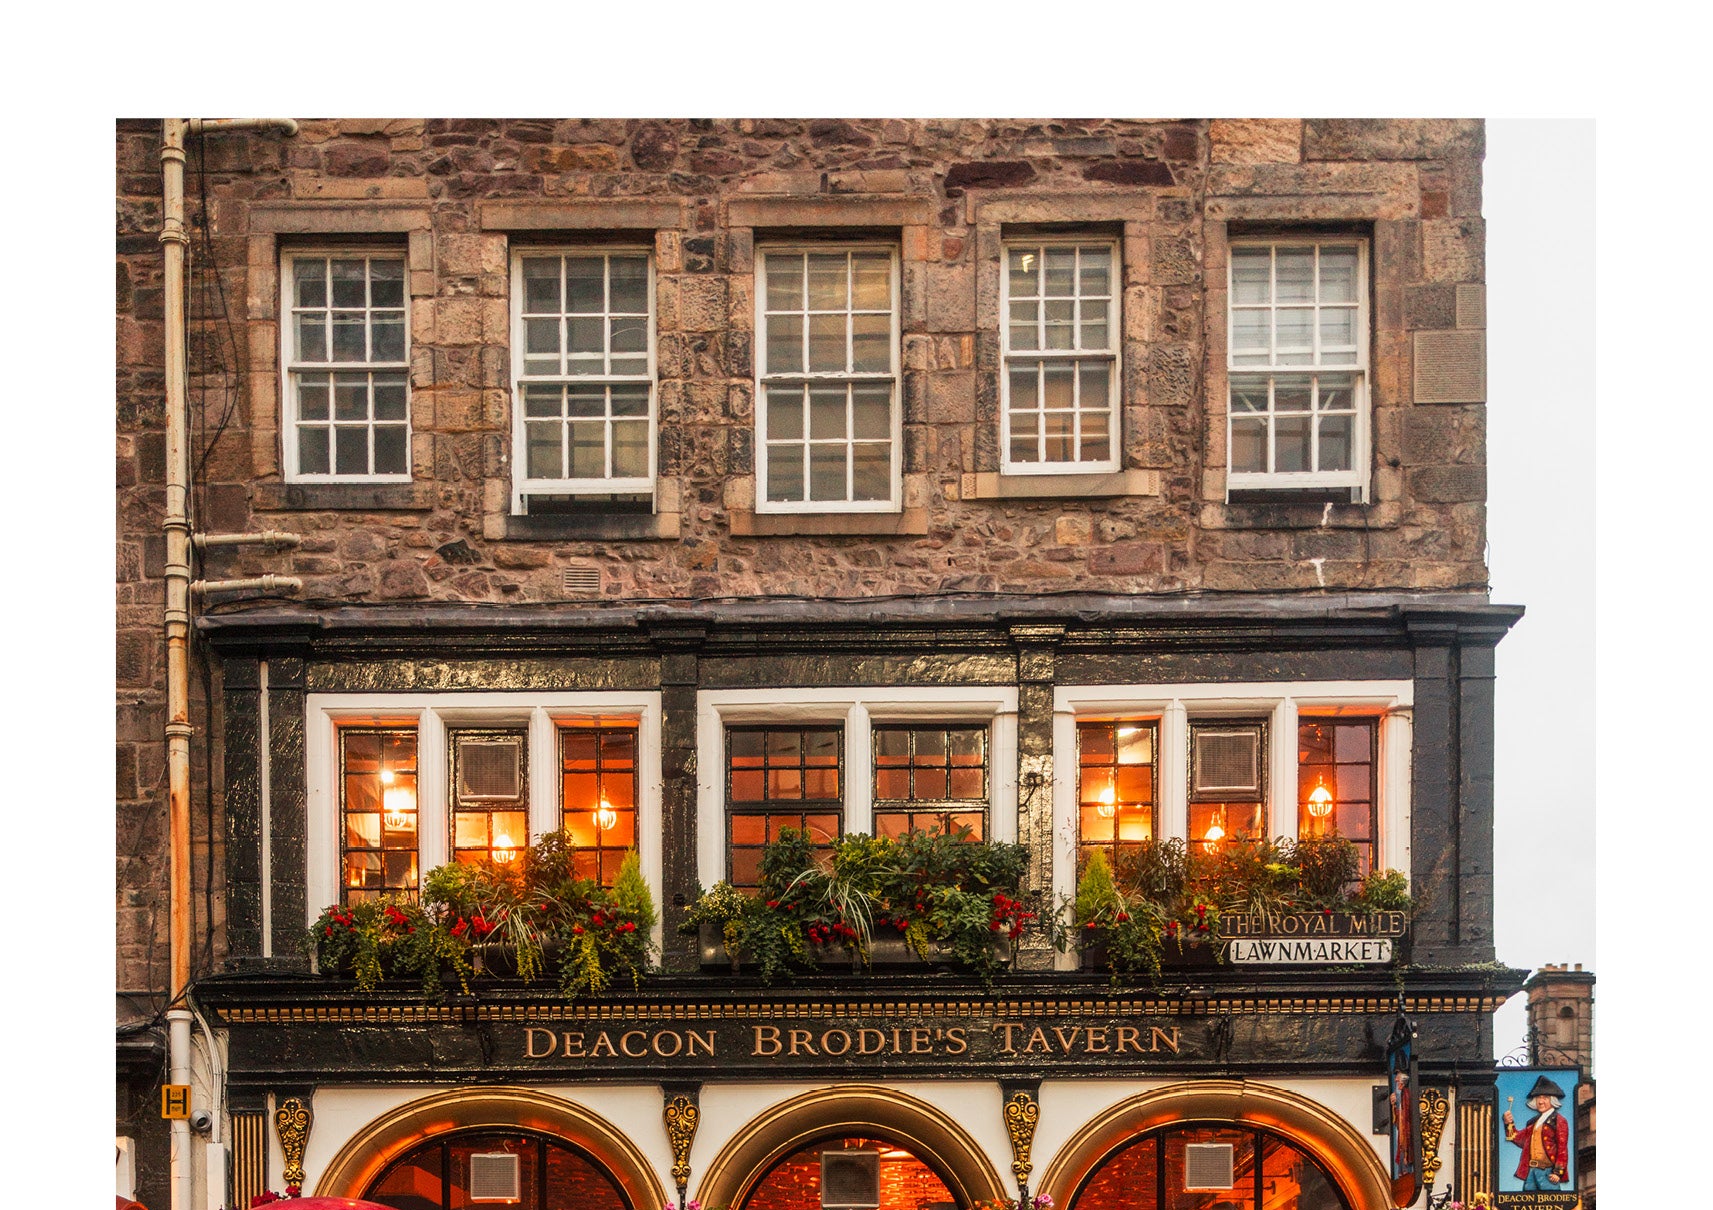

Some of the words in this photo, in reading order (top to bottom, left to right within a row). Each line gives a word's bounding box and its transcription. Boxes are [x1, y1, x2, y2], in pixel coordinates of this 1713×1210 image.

[1222, 915, 1262, 934] THE
[1269, 915, 1340, 934] ROYAL
[1350, 914, 1400, 934] MILE
[1234, 941, 1386, 961] LAWNMARKET
[523, 1027, 717, 1059] DEACON
[752, 1025, 968, 1057] BRODIE'S
[993, 1023, 1183, 1055] TAVERN
[1498, 1195, 1534, 1204] DEACON
[1537, 1194, 1577, 1204] BRODIE'S
